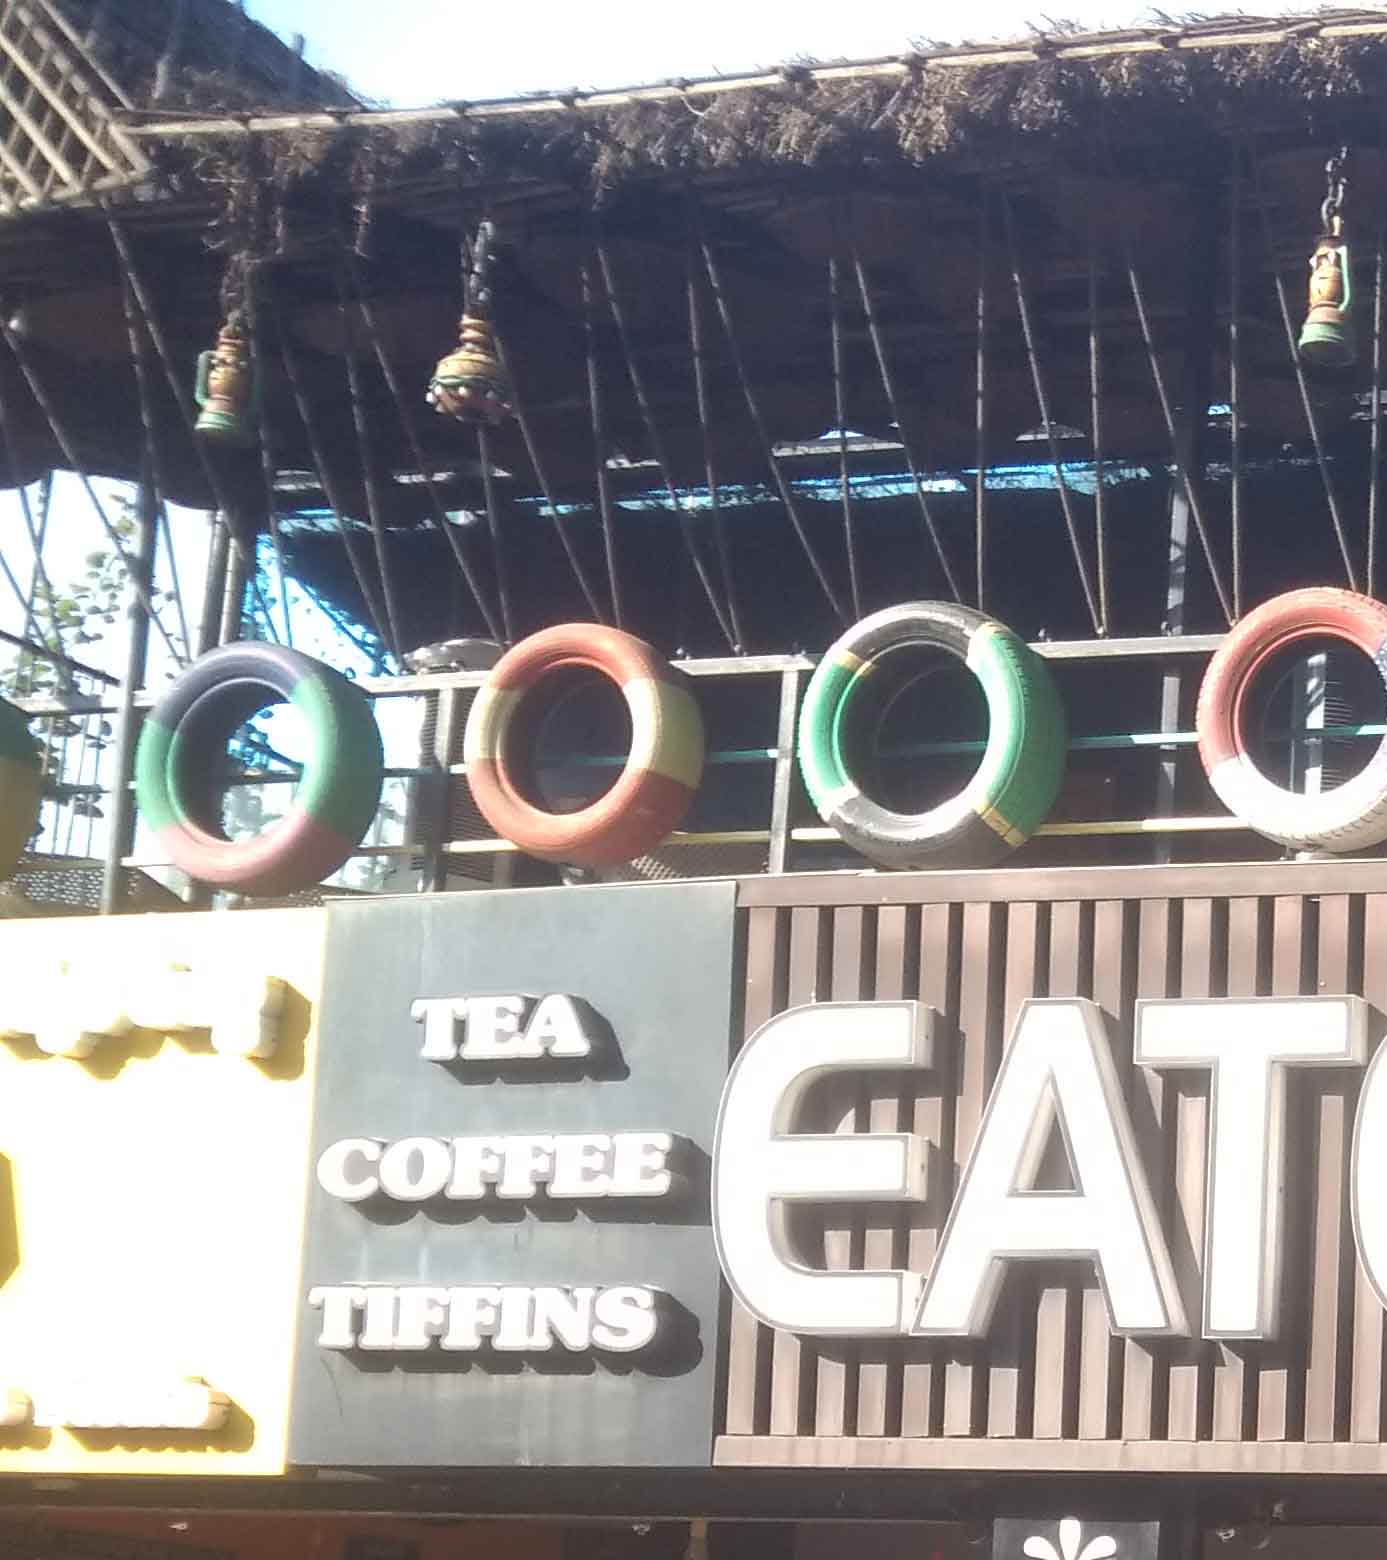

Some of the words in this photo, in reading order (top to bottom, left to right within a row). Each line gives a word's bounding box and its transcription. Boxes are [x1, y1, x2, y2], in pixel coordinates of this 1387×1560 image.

[411, 995, 591, 1061] TEA
[316, 1132, 673, 1202] COFFEE
[309, 1284, 658, 1353] TIFFINS
